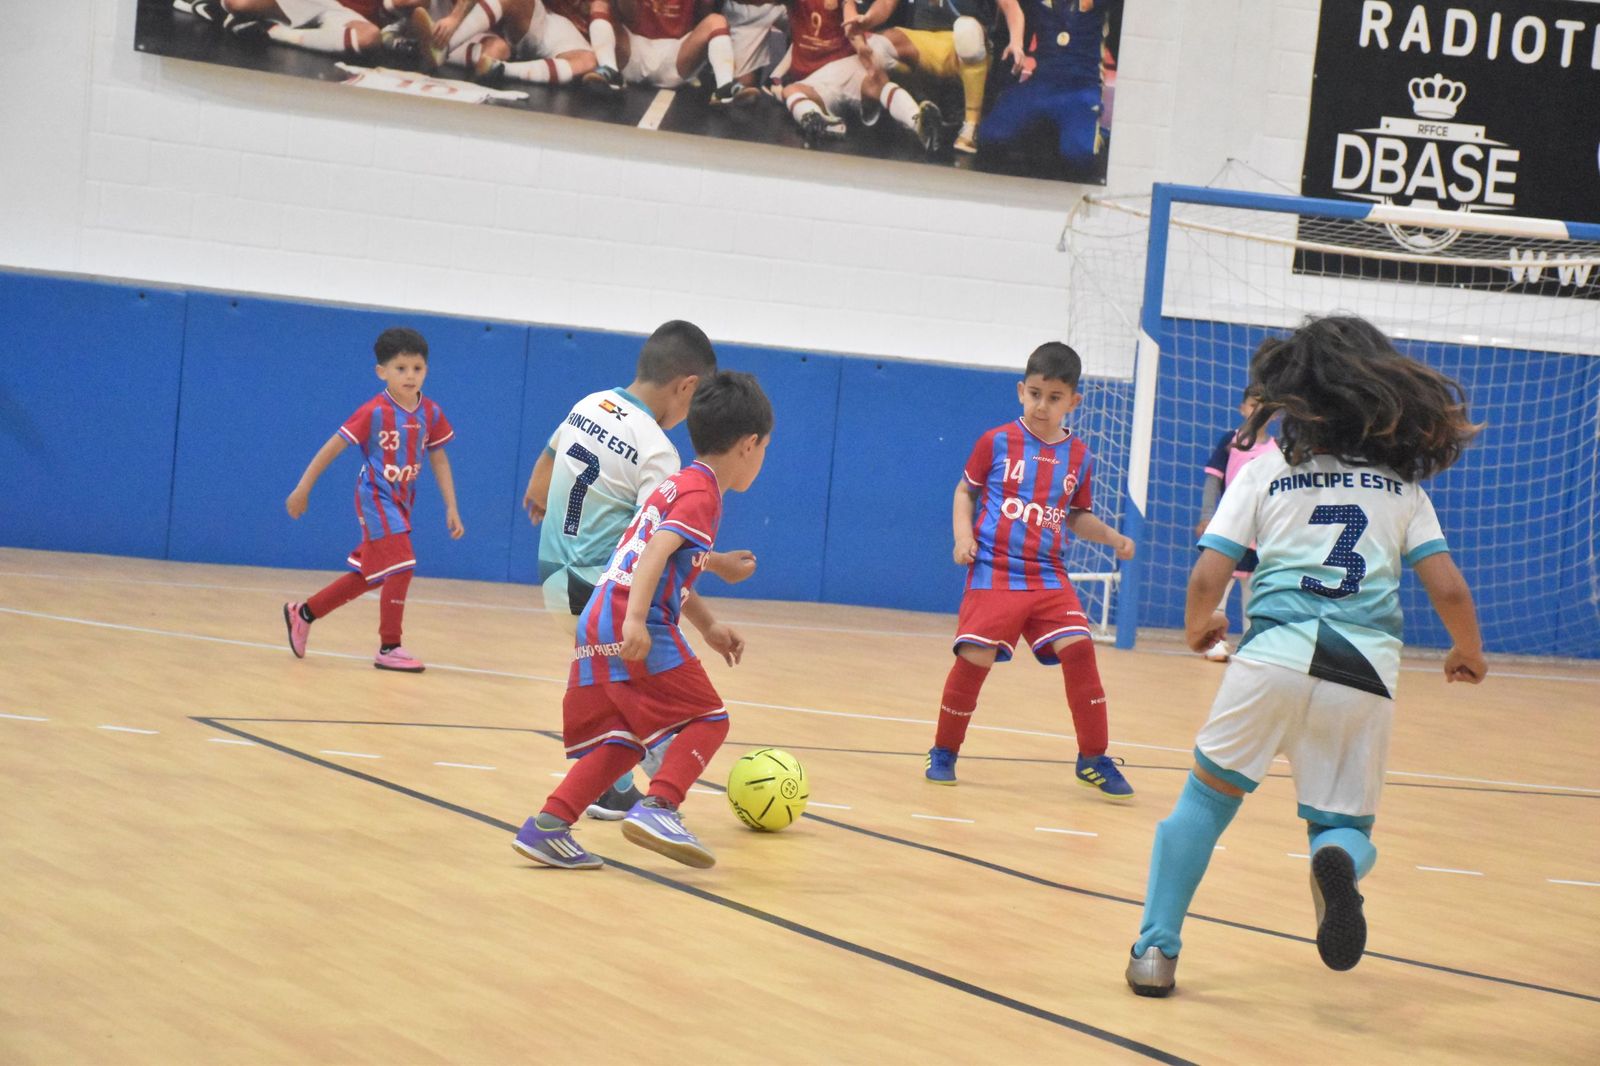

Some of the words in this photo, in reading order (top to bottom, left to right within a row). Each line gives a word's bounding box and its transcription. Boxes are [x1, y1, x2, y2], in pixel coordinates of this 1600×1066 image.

[1359, 0, 1600, 70] RADIOT
[1418, 124, 1449, 137] RFFCE
[1332, 133, 1520, 205] DBASE
[379, 430, 400, 450] 23
[563, 443, 600, 537] 7
[1002, 458, 1026, 484] 14
[1269, 472, 1354, 496] PRINCIPE
[1360, 472, 1403, 495] ESTE
[1299, 504, 1369, 600] 3
